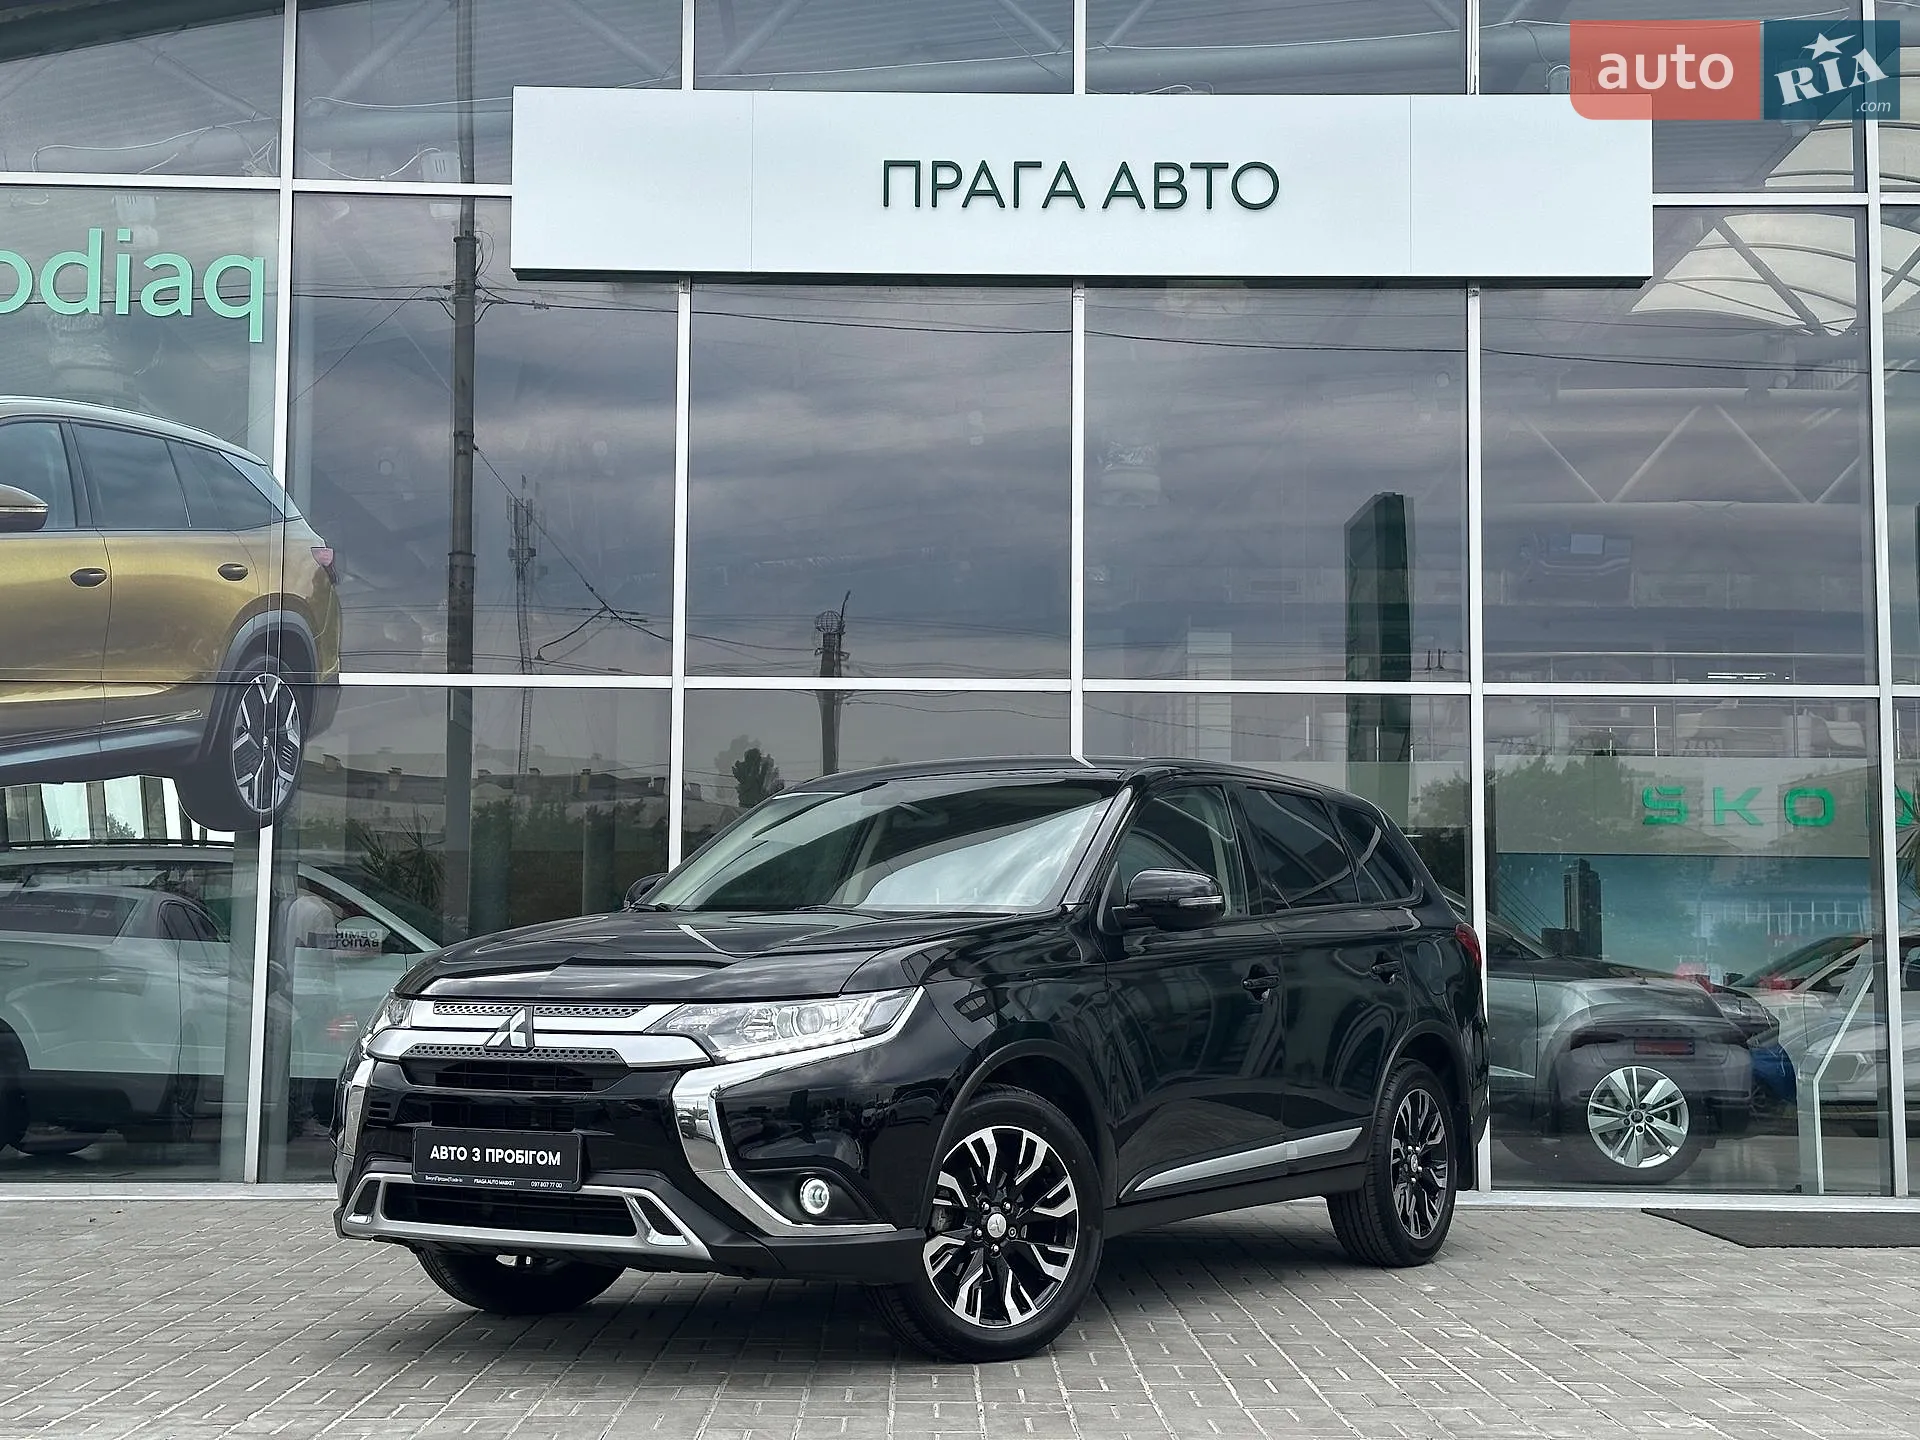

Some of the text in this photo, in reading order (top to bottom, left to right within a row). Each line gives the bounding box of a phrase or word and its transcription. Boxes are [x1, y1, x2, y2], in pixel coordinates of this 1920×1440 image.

[883, 160, 1280, 211] ПРАГА АВТО
[429, 1145, 468, 1161] АВТО
[485, 1148, 561, 1166] ПРОБІГОМ
